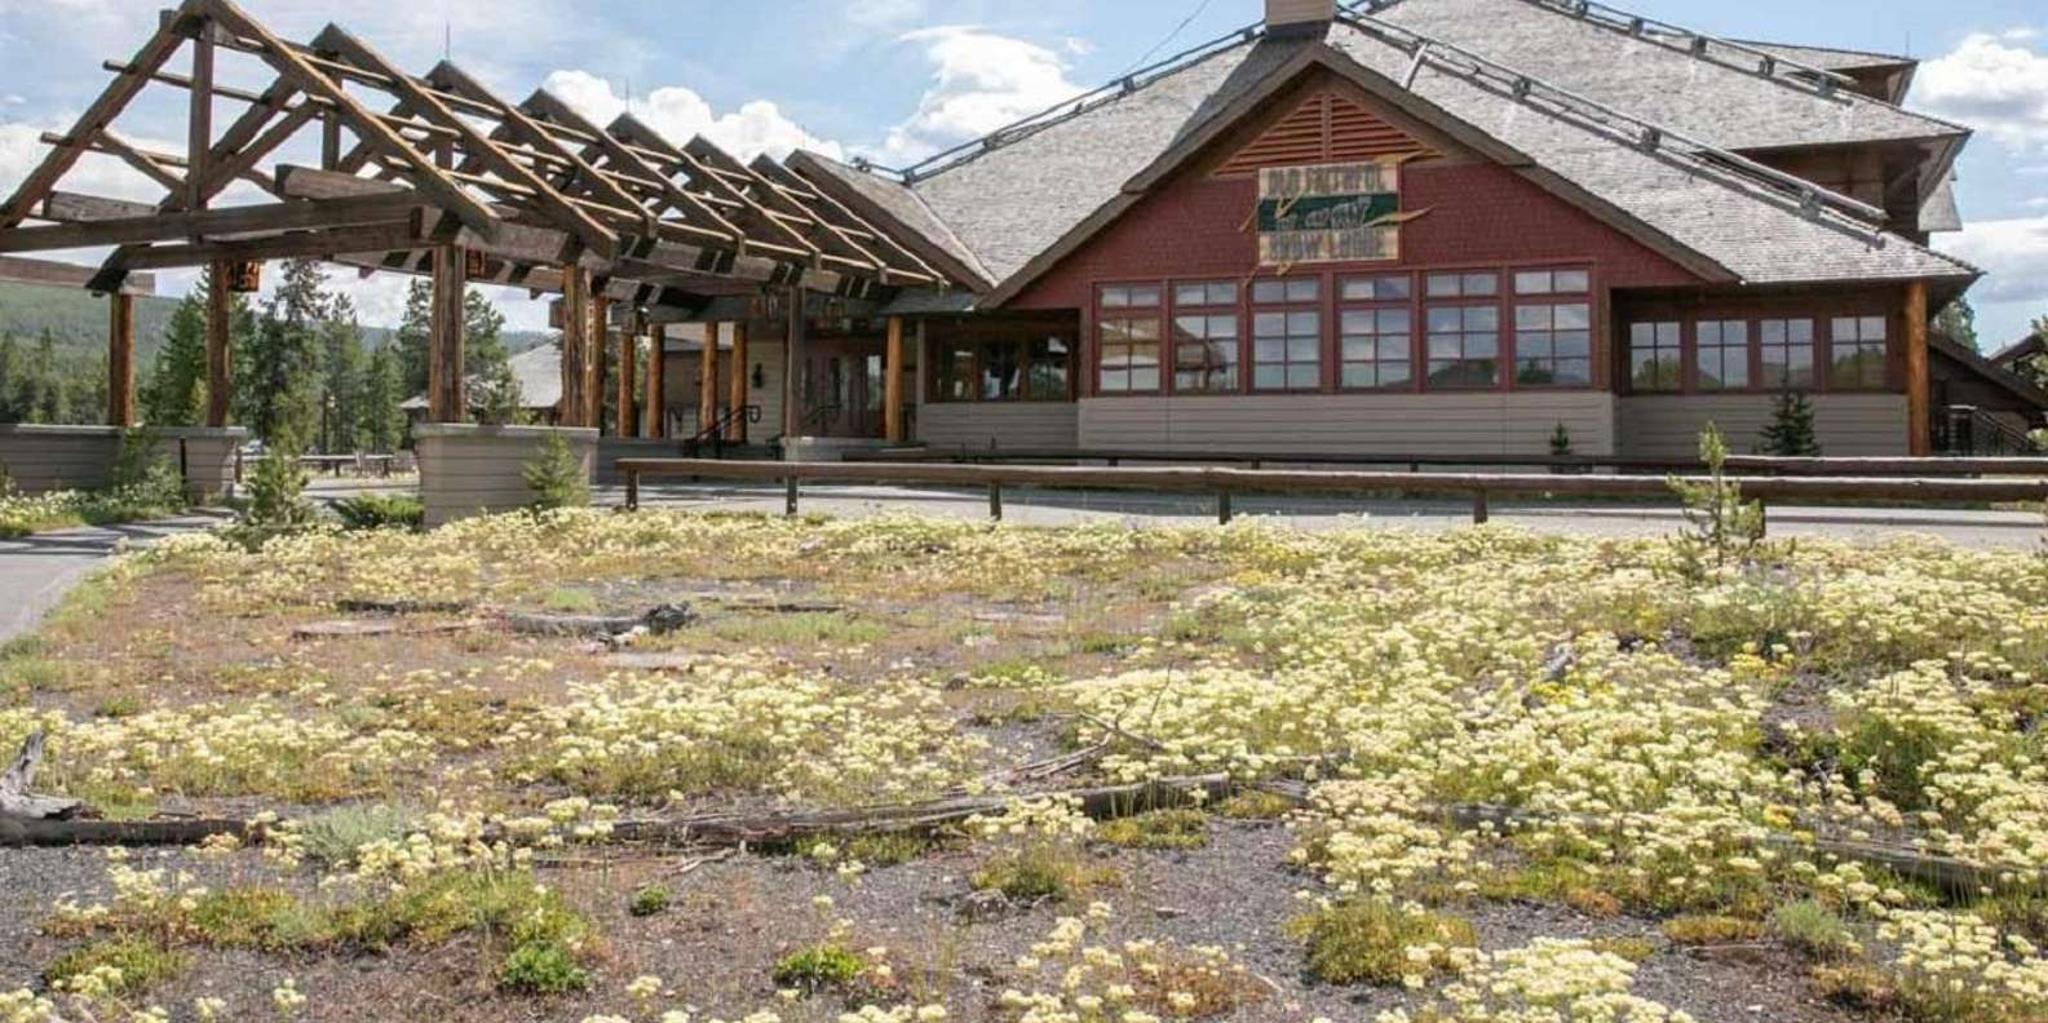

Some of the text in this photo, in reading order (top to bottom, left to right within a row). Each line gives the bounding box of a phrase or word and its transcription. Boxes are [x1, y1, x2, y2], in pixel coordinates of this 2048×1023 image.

[1268, 164, 1384, 194] OLD FAITHFUL
[1269, 229, 1384, 260] SNOW LODGE
